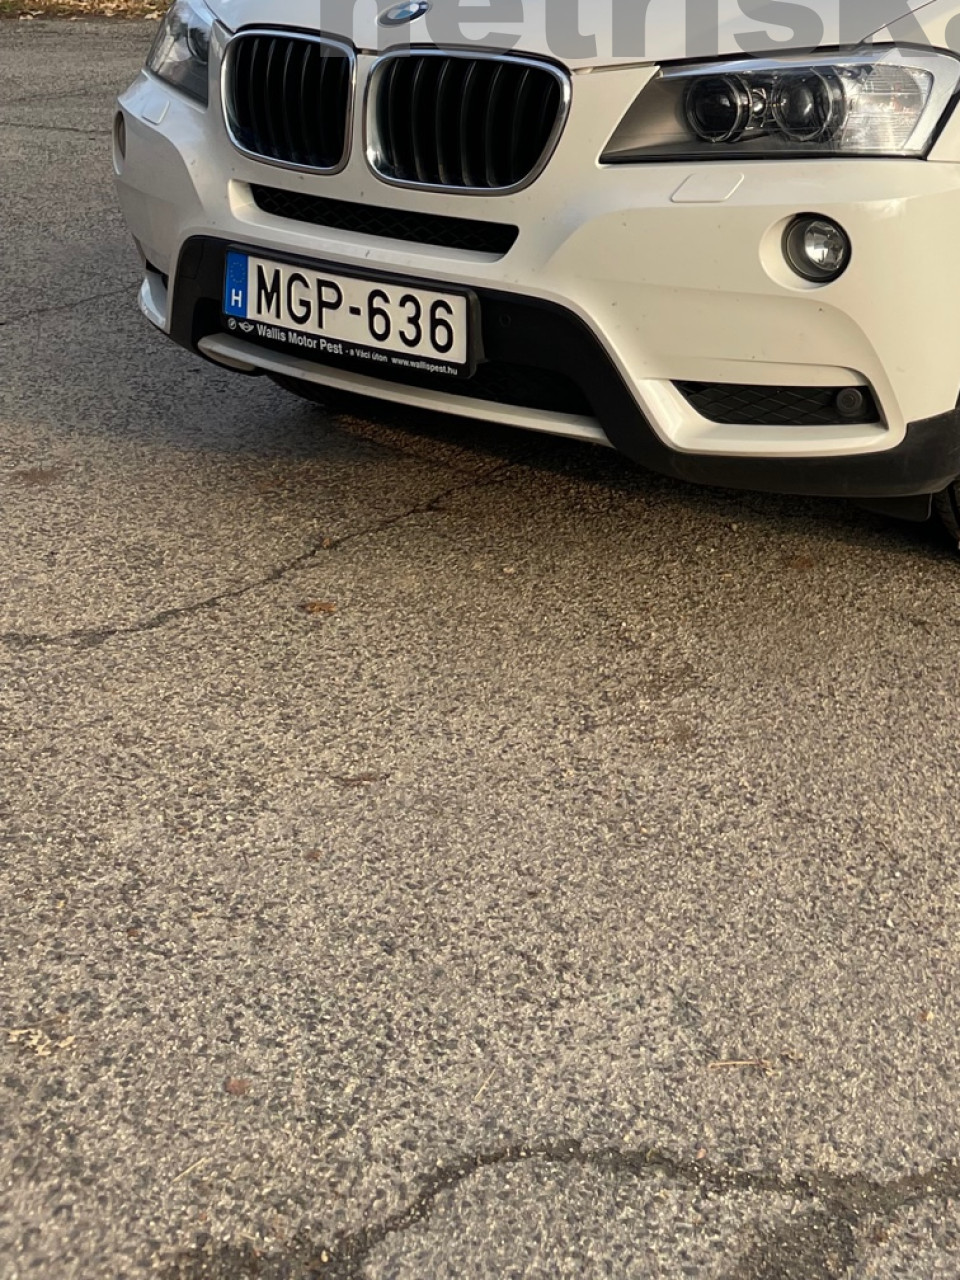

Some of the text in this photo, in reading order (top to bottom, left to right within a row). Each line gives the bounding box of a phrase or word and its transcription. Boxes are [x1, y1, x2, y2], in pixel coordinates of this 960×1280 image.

[230, 288, 242, 308] H
[256, 264, 454, 354] MGP-636
[256, 323, 286, 341] Wallis
[288, 331, 318, 349] Motor
[319, 338, 344, 355] Pest
[391, 357, 459, 376] www.wallispest.hu
